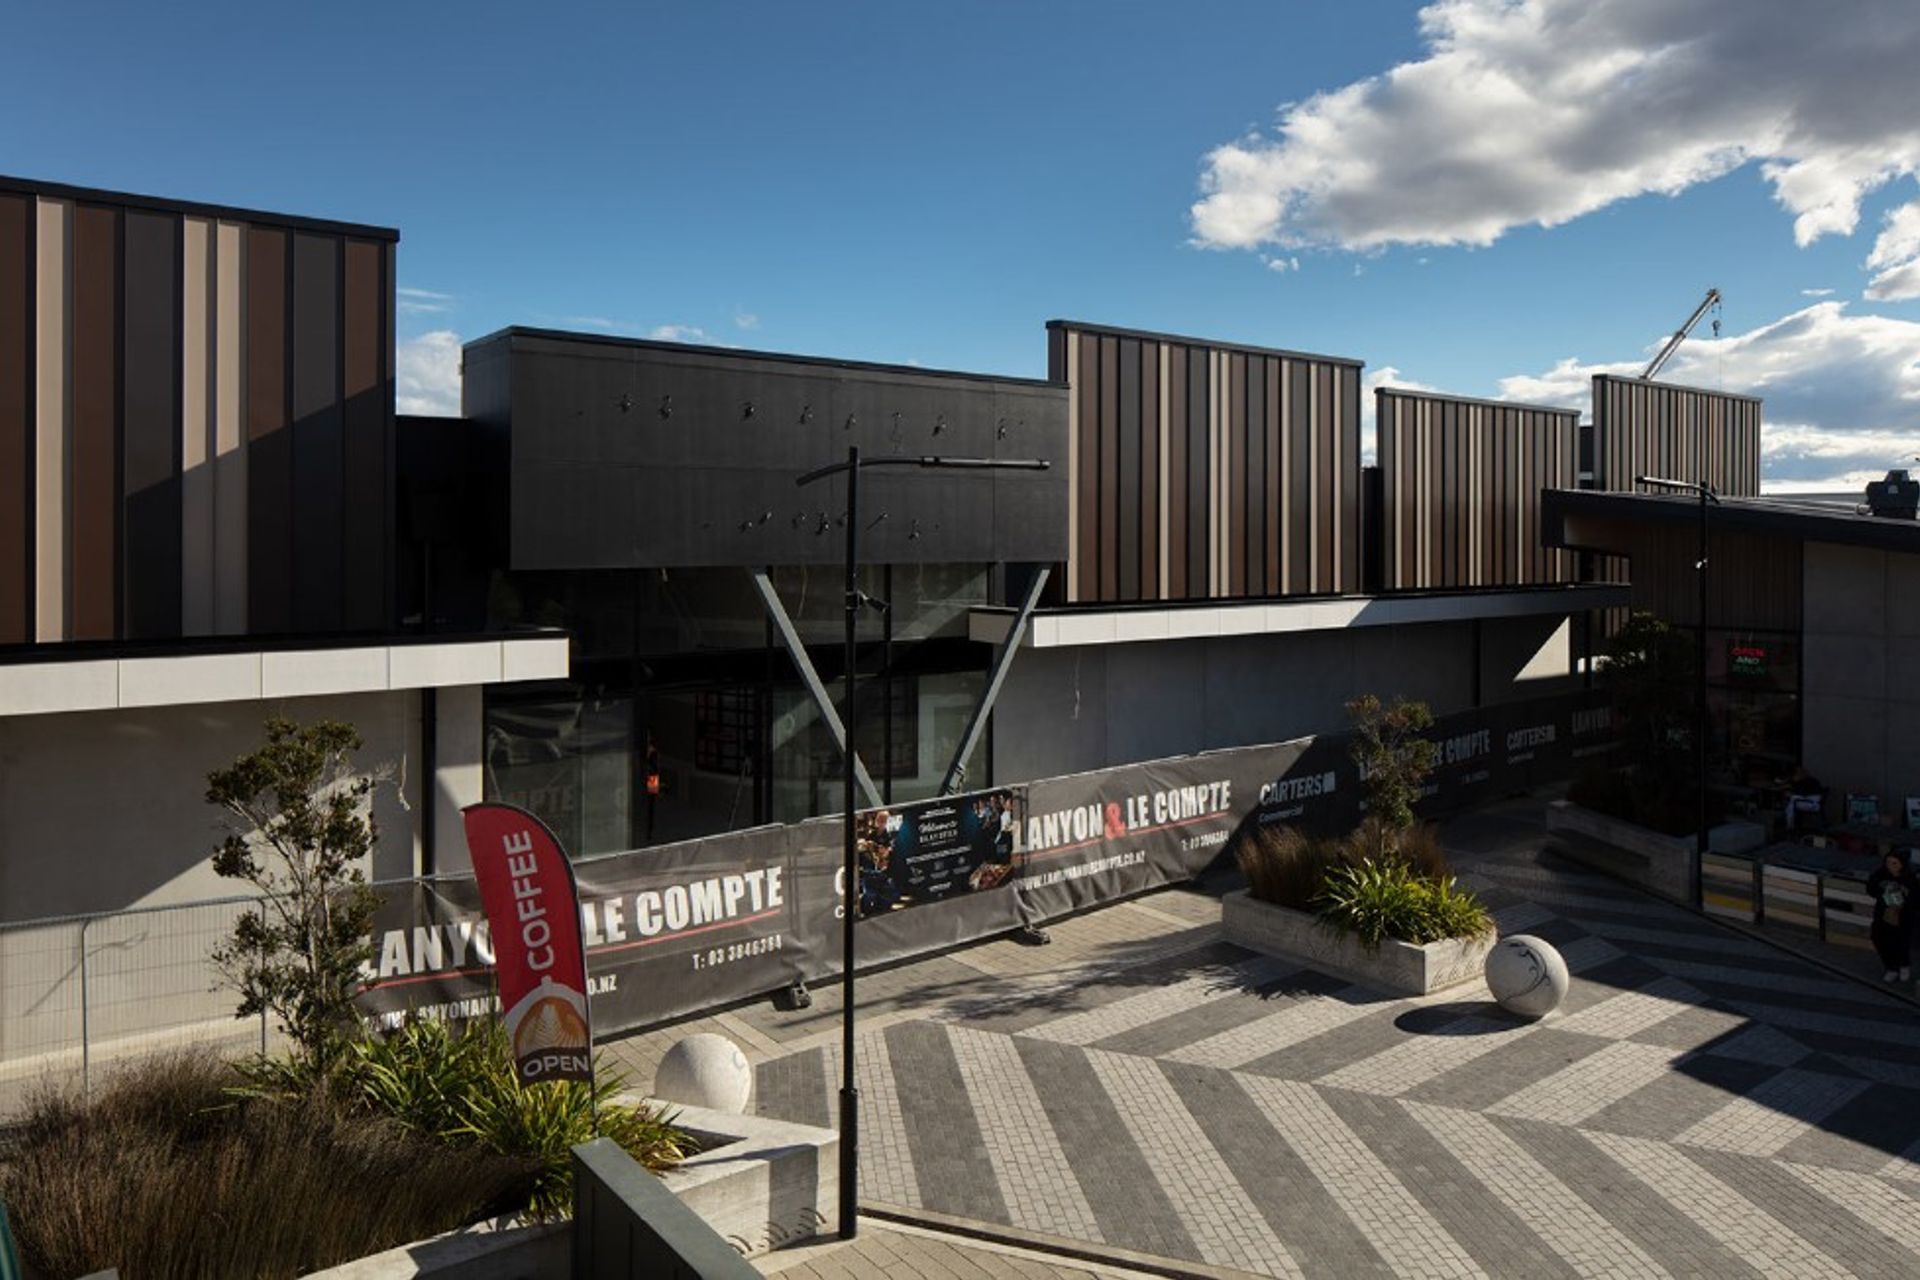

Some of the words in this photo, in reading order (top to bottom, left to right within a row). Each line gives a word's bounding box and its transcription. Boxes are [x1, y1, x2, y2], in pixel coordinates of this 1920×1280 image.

[1012, 803, 1103, 854] LANYON
[1104, 802, 1125, 840] &
[1127, 795, 1149, 830] LE
[1154, 780, 1231, 824] COMPTE
[1259, 774, 1322, 806] CARTERS
[357, 918, 497, 981] LANYO
[581, 897, 627, 946] LE
[636, 866, 784, 936] COMPTE
[503, 830, 555, 971] COFFEE
[523, 1056, 590, 1077] OPEN
